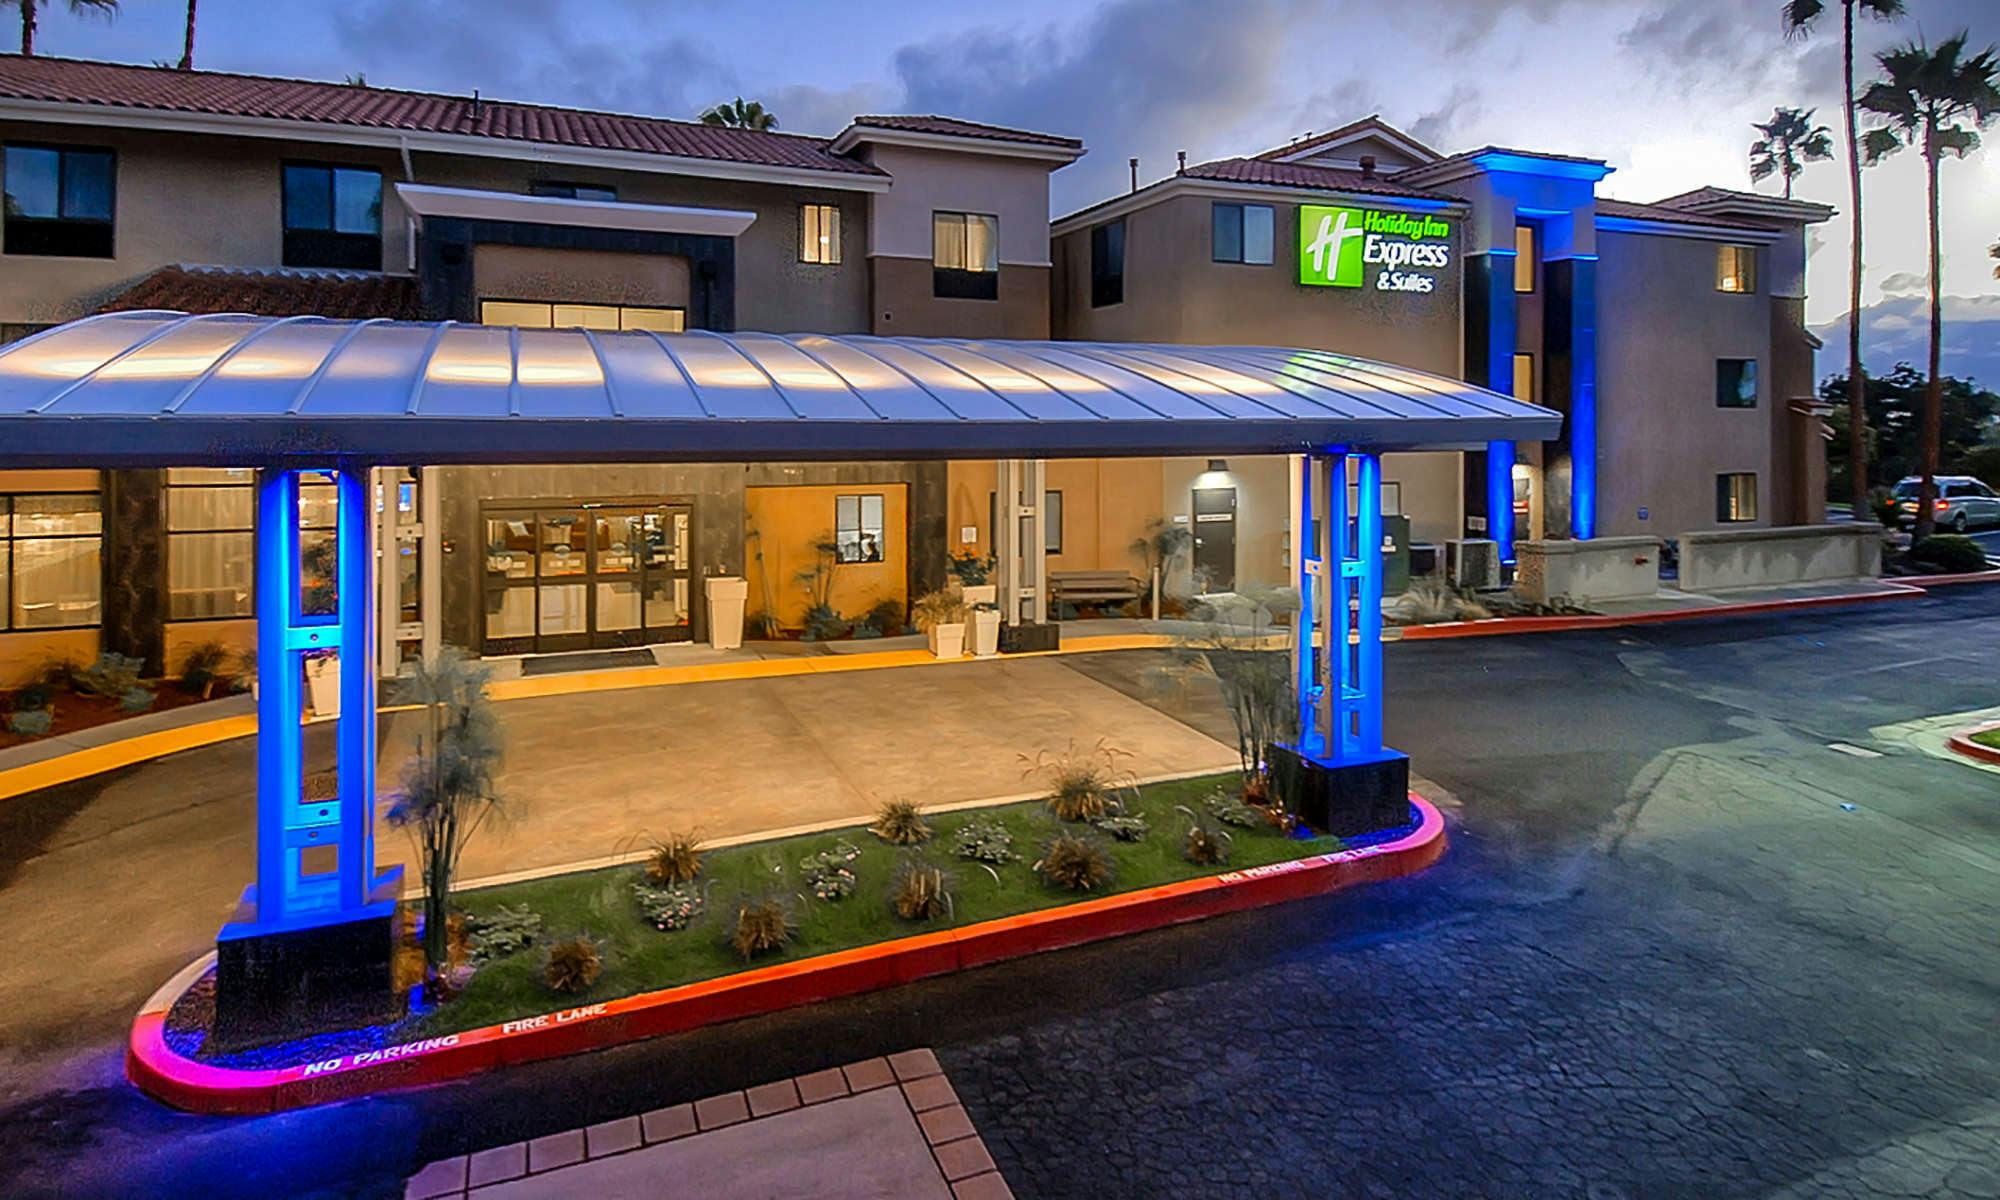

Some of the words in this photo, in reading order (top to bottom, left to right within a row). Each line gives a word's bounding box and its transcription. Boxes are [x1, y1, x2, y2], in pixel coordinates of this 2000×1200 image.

[1364, 211, 1424, 240] Holiday
[1424, 215, 1449, 237] Inn
[1363, 234, 1449, 271] Express
[1390, 272, 1433, 292] Suites
[503, 1014, 549, 1034] FIRE
[556, 1003, 607, 1022] LANE
[304, 1058, 342, 1076] NO
[353, 1035, 459, 1065] PARKING
